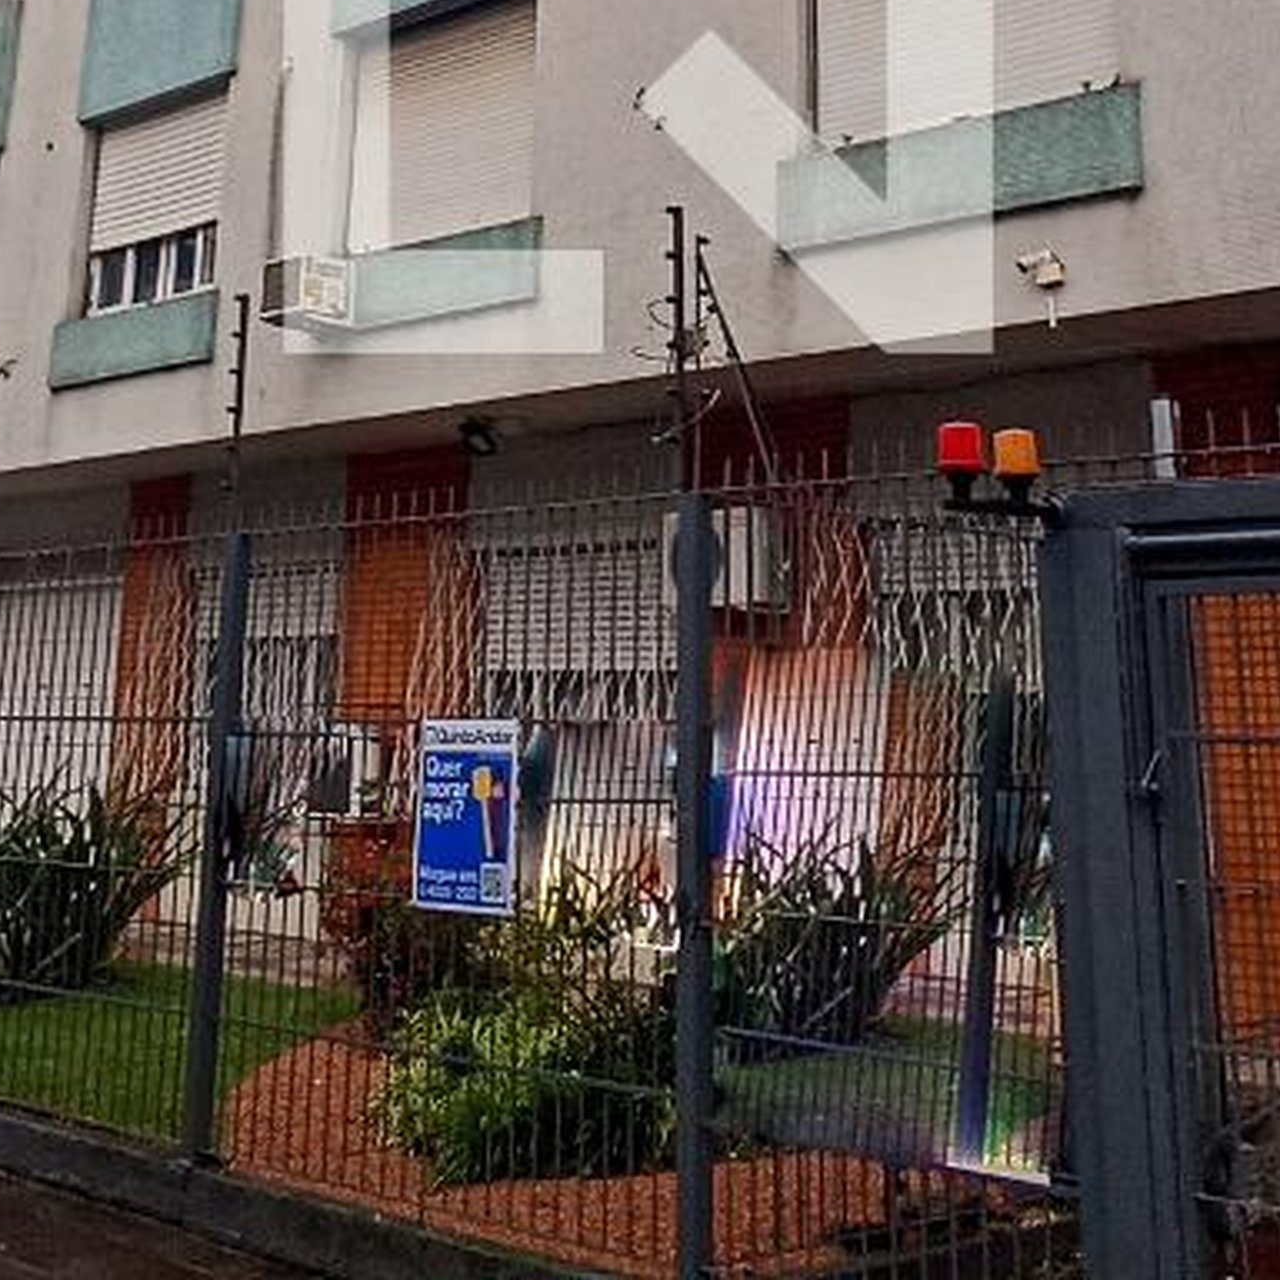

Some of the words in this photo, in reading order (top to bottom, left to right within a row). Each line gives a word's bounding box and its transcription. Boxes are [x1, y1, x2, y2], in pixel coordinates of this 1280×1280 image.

[425, 756, 462, 778] Quer
[424, 782, 471, 798] morar
[423, 799, 465, 824] aqui?
